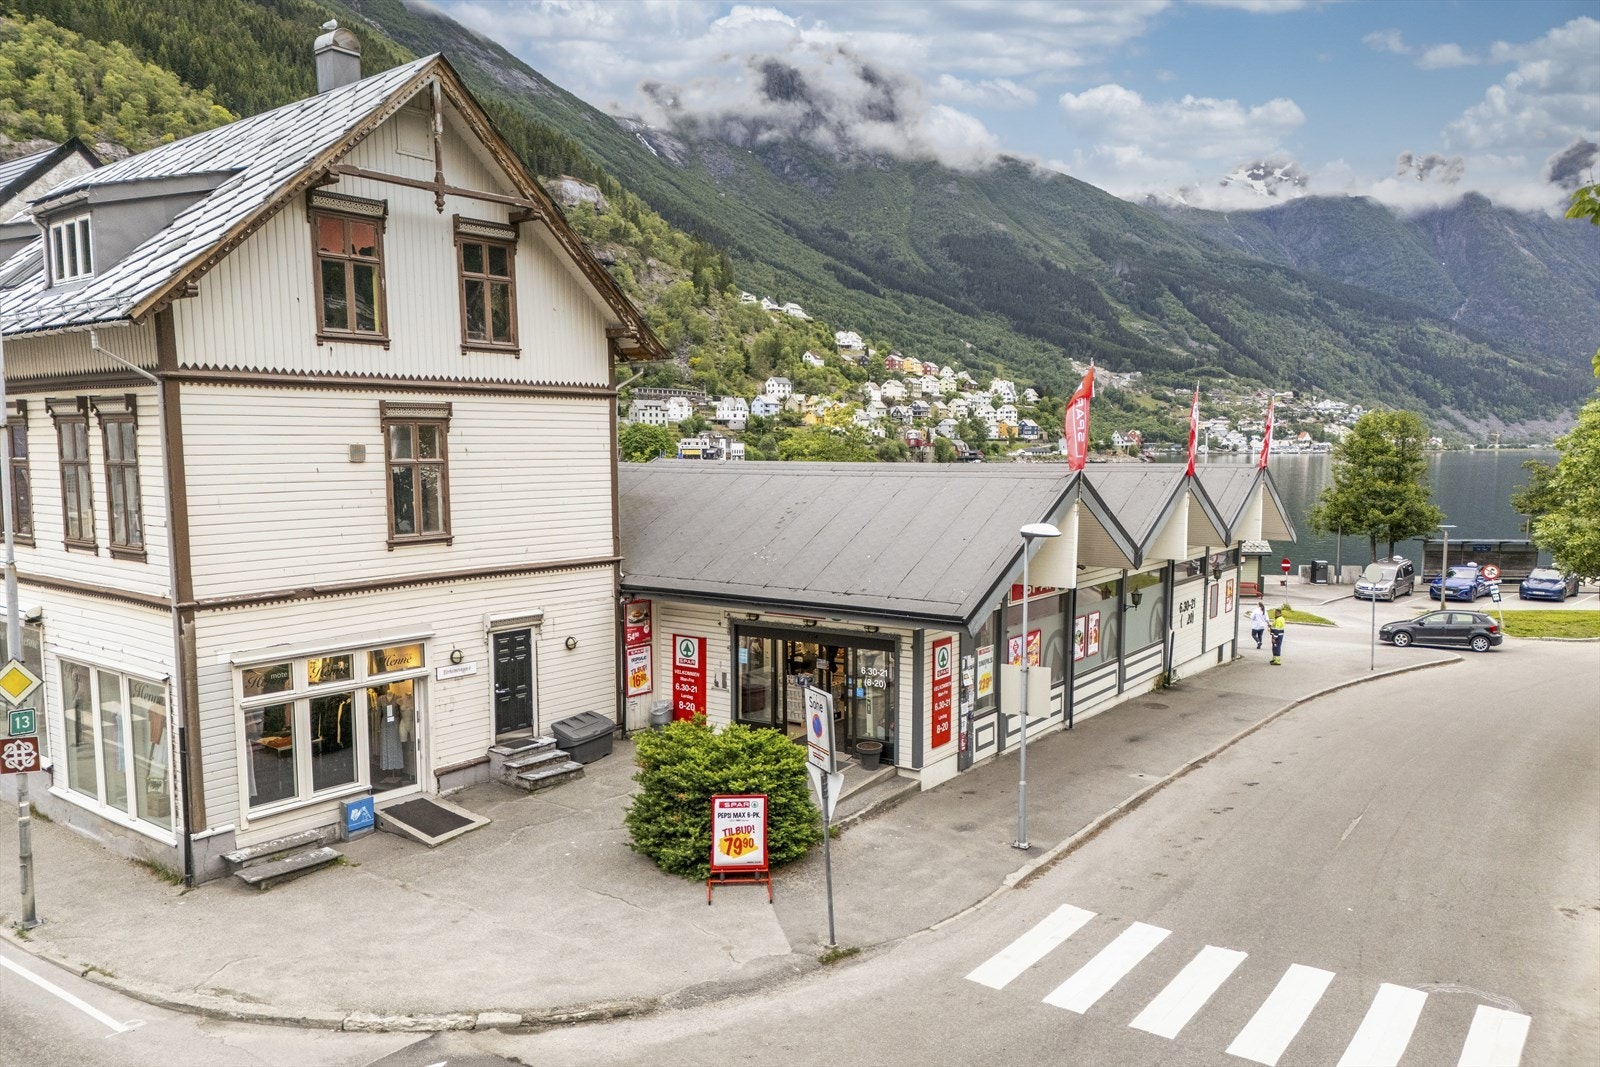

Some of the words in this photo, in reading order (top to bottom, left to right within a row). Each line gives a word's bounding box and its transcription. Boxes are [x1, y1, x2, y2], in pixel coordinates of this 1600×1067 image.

[270, 671, 288, 680] mote
[674, 669, 700, 677] VELKOMMEN
[861, 666, 888, 677] 6.30-21
[675, 683, 698, 693] 6.30-21
[864, 678, 887, 690] (8-20)
[678, 700, 696, 711] 8-20
[808, 695, 824, 713] Sone
[934, 699, 951, 711] 6.30-21
[15, 715, 30, 730] 13
[936, 721, 949, 734] 8-20
[722, 825, 755, 837] TILBUD!
